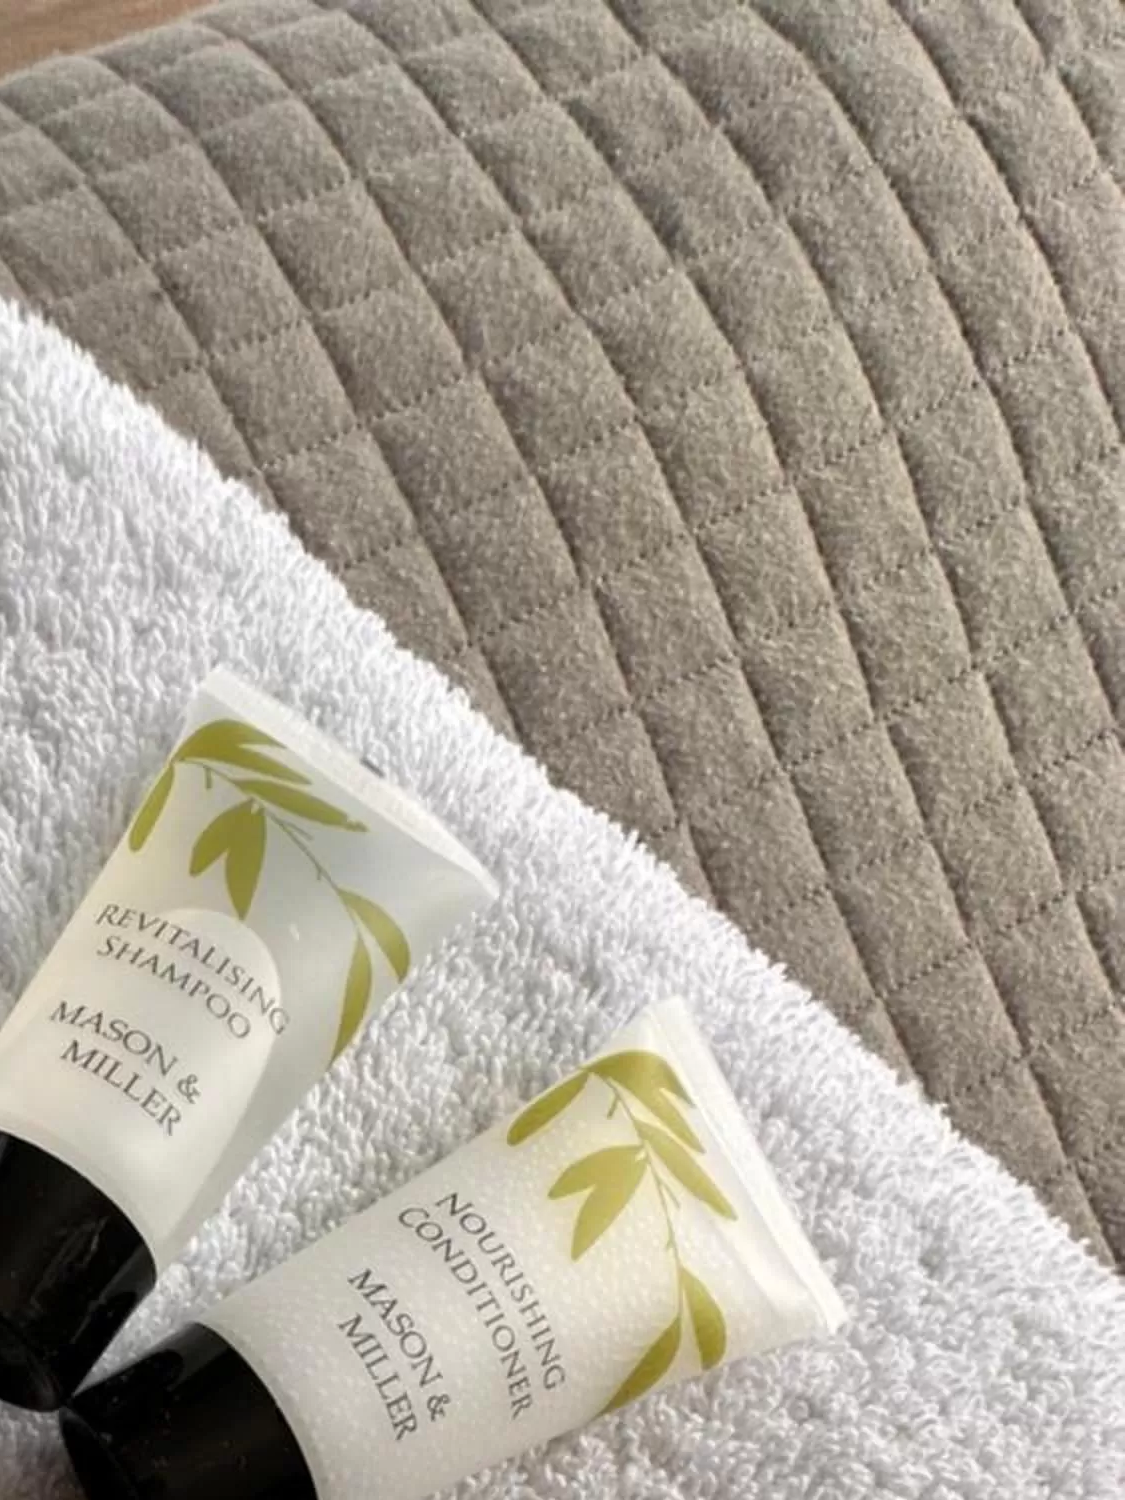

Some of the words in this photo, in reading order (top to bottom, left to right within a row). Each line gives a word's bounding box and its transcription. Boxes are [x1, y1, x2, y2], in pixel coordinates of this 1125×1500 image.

[96, 903, 290, 1035] REVITALISING
[97, 935, 251, 1039] SHAMPOO
[49, 1000, 178, 1077] MASON
[177, 1073, 202, 1104] &
[60, 1040, 182, 1137] MILLER
[347, 1268, 443, 1388] MASON
[427, 1392, 451, 1422] &
[398, 1207, 533, 1421] CONDITIONER
[435, 1192, 566, 1391] NOURISHING
[337, 1313, 418, 1441] MILLER
